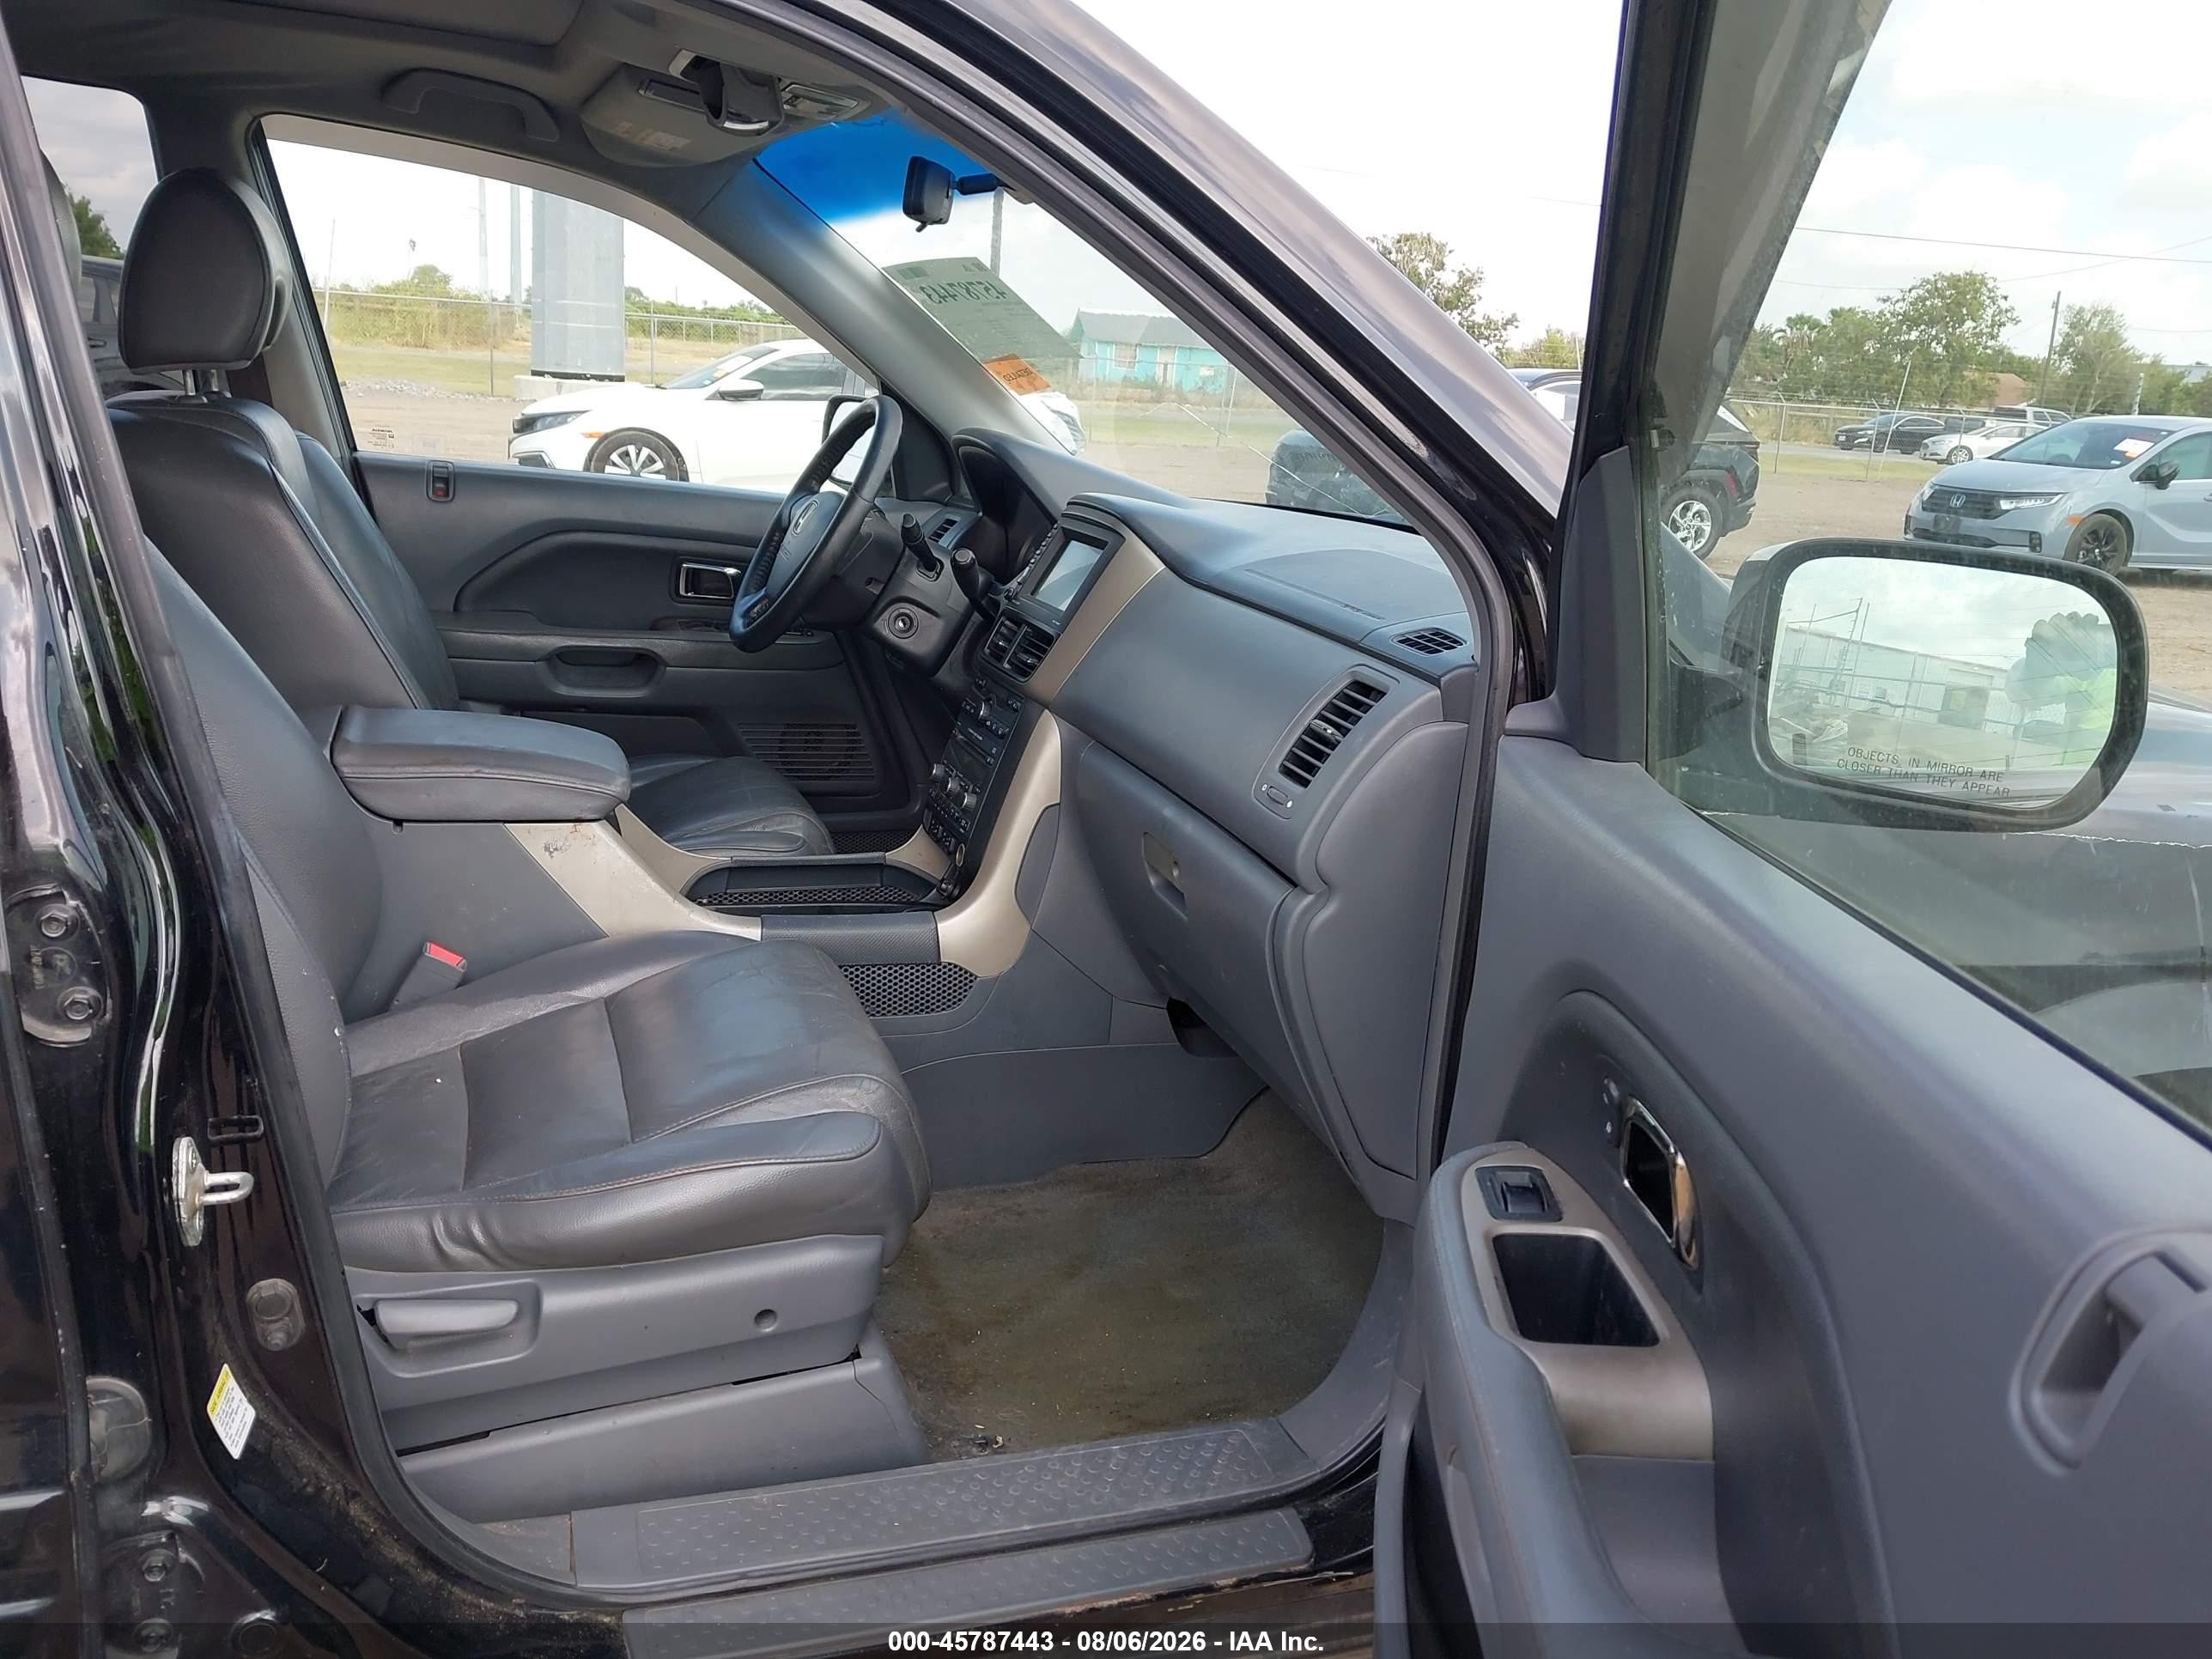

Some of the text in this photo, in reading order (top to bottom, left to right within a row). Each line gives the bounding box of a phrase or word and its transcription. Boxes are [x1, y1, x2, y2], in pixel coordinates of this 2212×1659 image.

[1836, 758, 2012, 798] CLOSER THAN THEY APPEAR
[1847, 746, 2005, 783] OBJECTS IN MIRROR ARE
